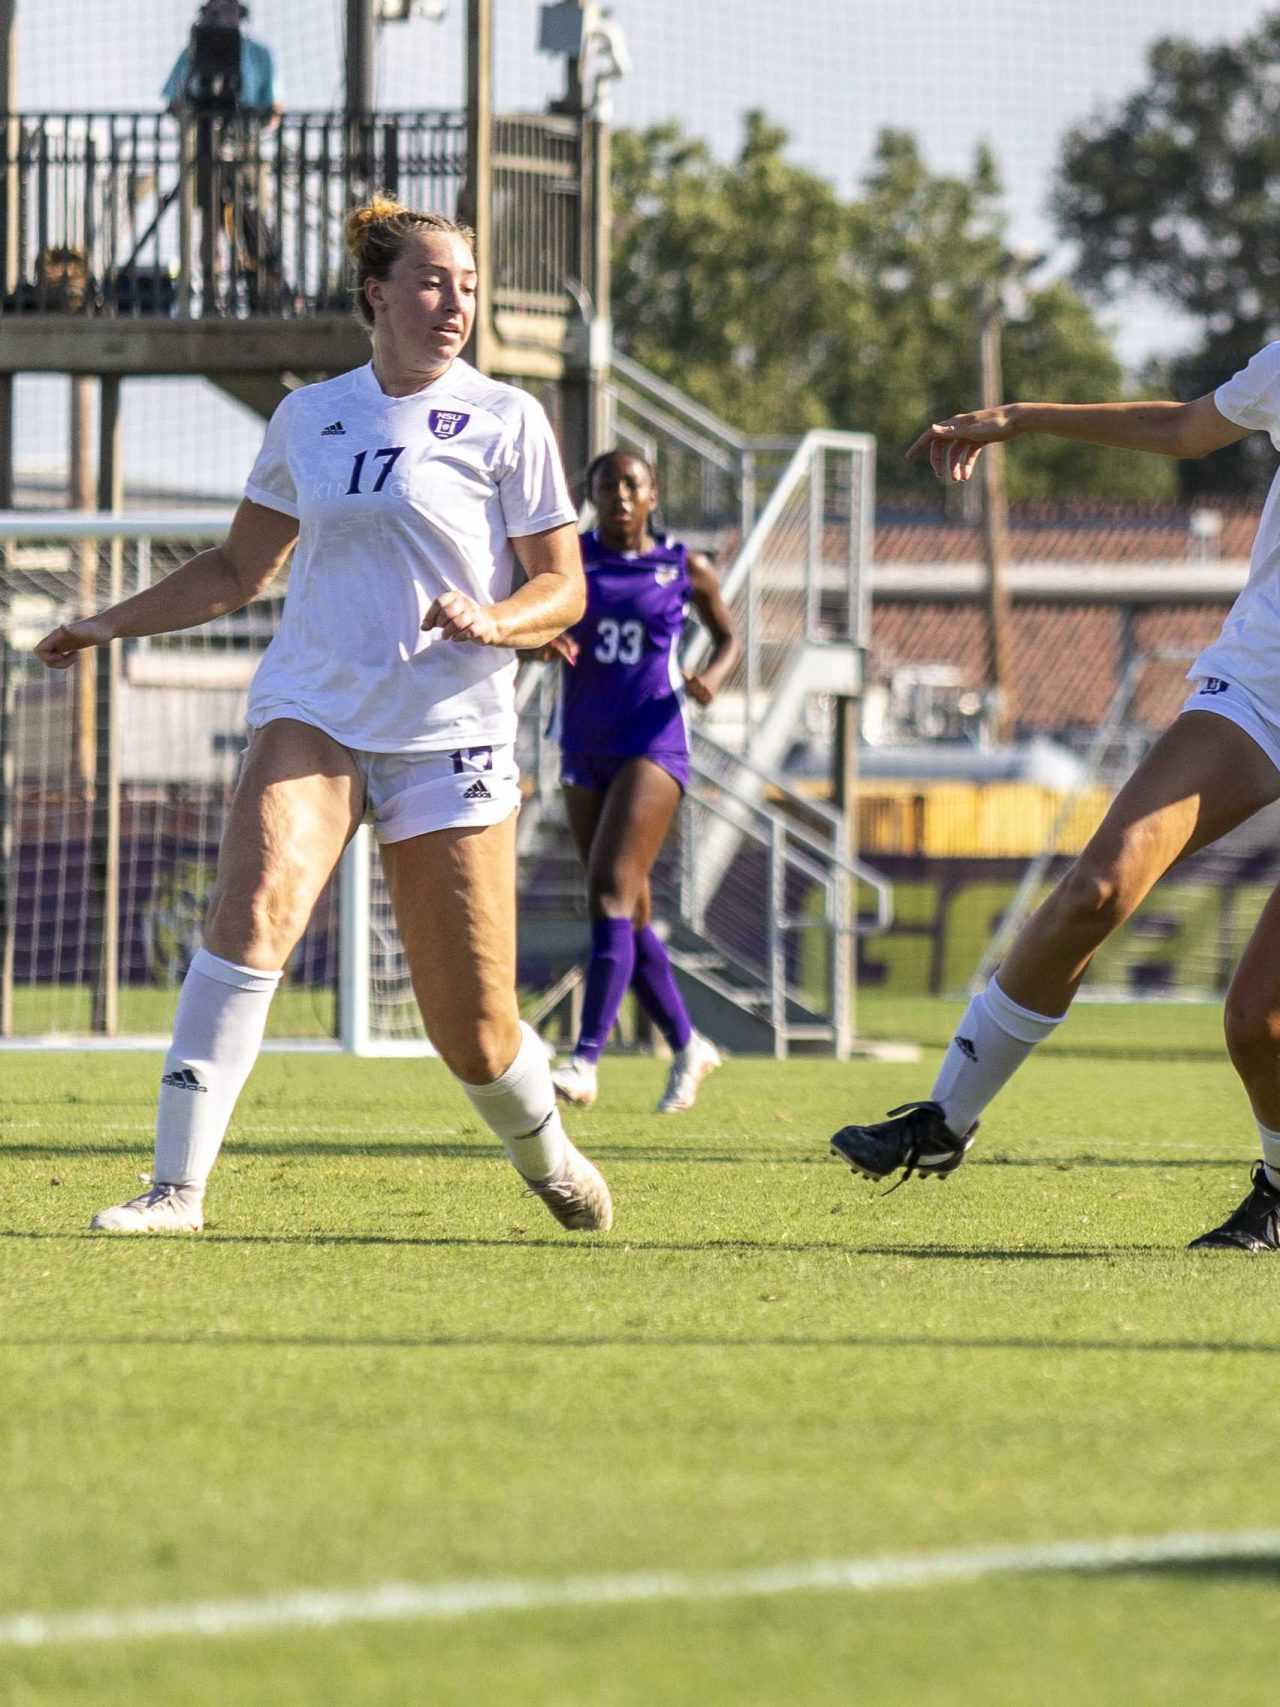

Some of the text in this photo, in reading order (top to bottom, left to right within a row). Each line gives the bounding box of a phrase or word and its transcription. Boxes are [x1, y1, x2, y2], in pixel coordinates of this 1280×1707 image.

[436, 411, 463, 421] NSU
[345, 446, 407, 496] 17
[594, 617, 643, 665] 33
